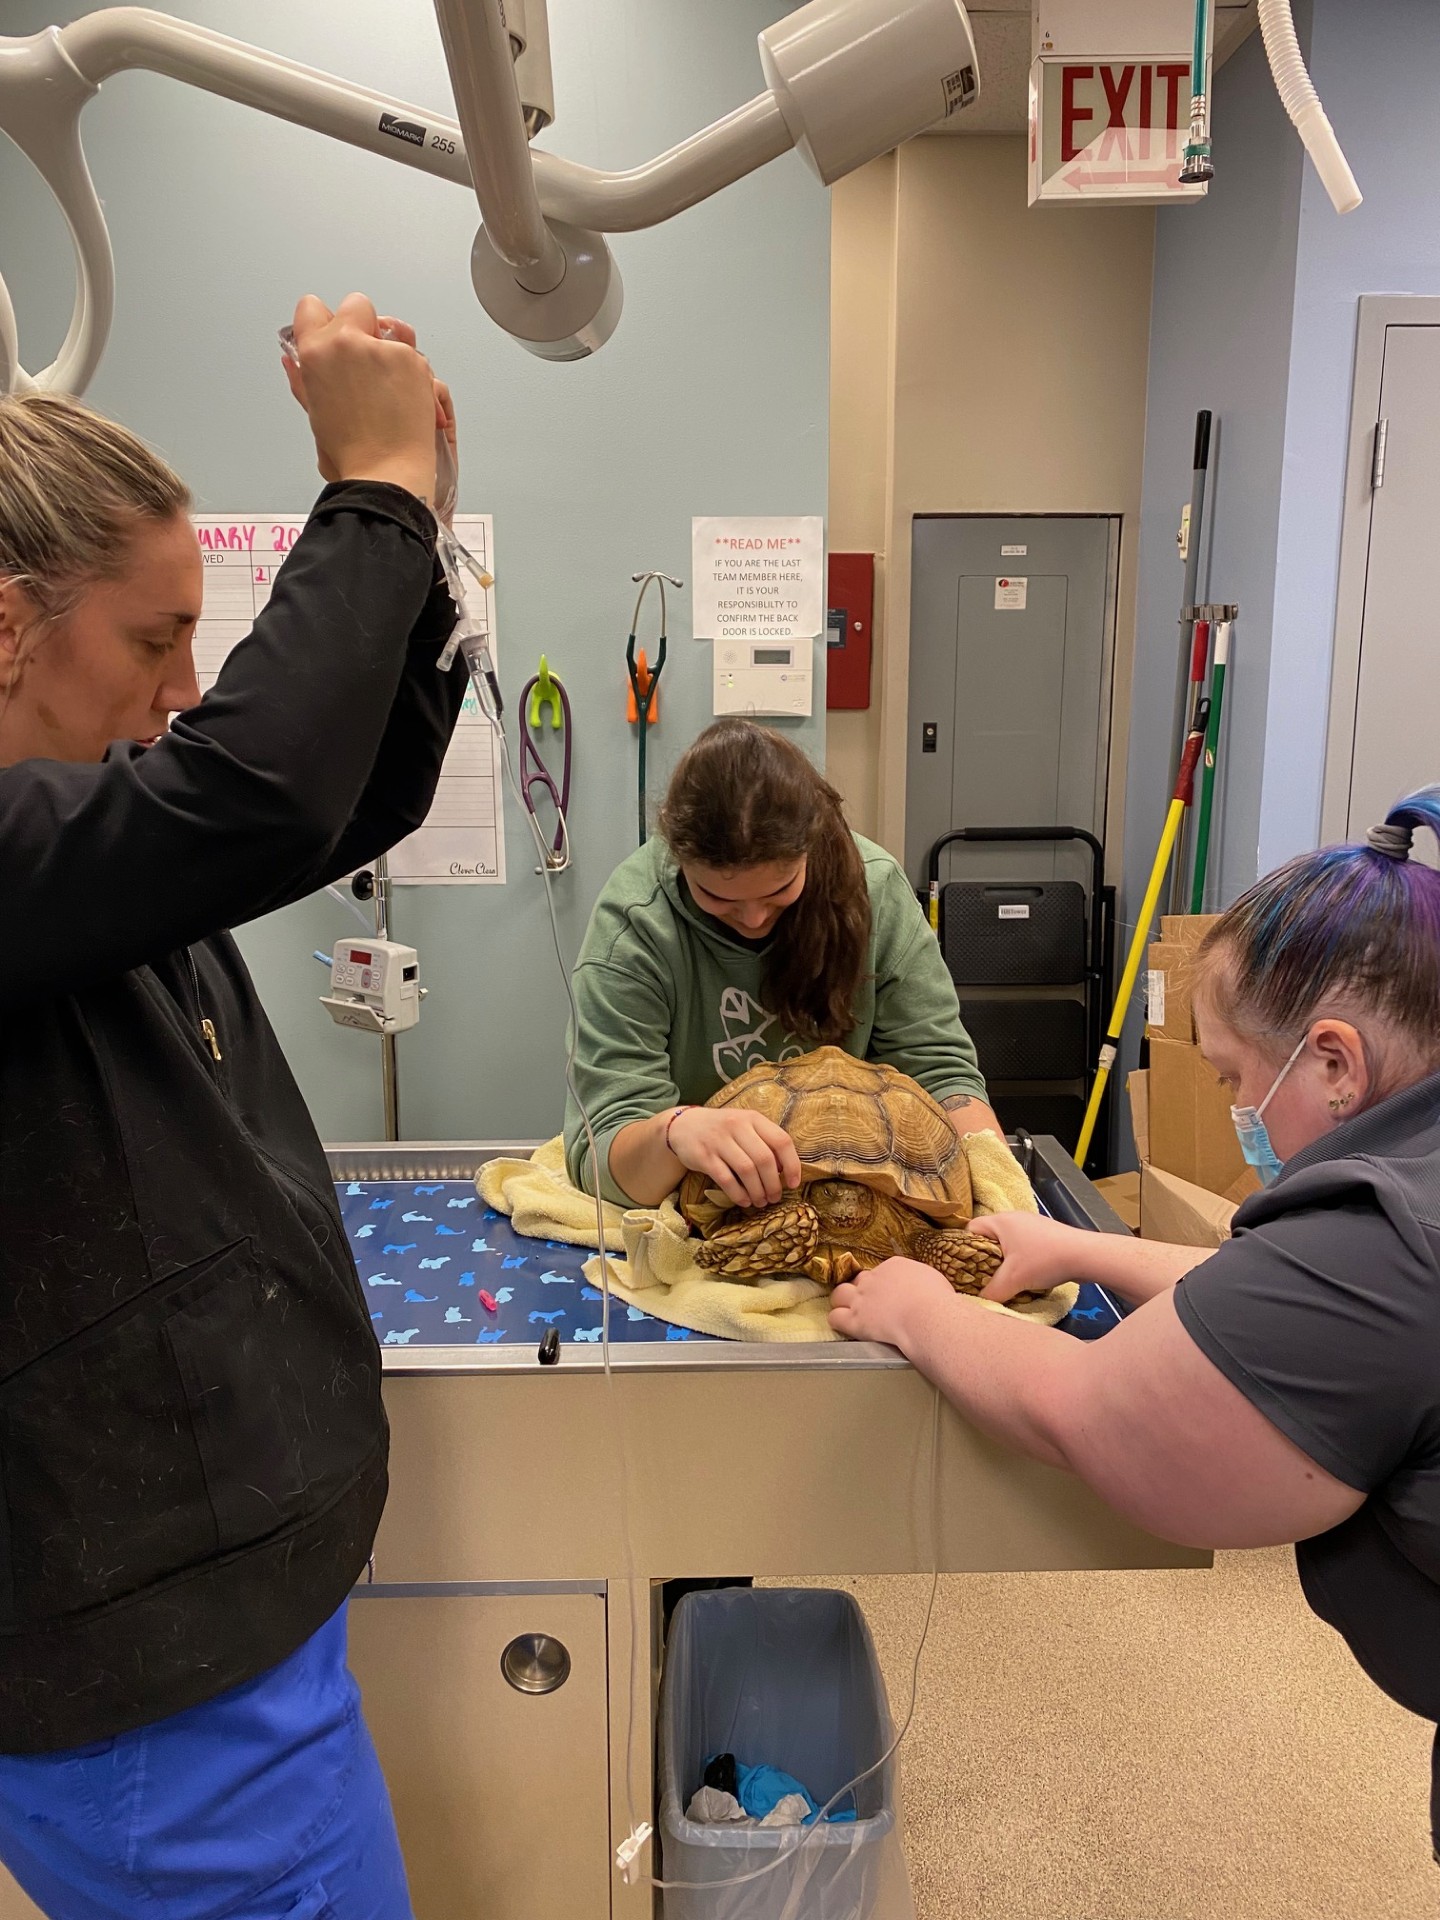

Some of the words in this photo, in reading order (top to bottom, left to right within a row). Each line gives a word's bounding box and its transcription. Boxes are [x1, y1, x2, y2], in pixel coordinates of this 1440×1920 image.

[1061, 64, 1190, 162] EXIT
[381, 122, 423, 143] MIDMARK
[431, 135, 456, 154] 255
[714, 559, 722, 567] IF
[725, 559, 742, 567] YOU
[745, 559, 760, 567] ARE
[764, 559, 779, 567] THE
[781, 559, 801, 567] LAST
[713, 573, 737, 581] TEAM
[739, 573, 777, 581] MEMBER
[780, 573, 803, 582] HERE,
[736, 587, 744, 595] IT
[746, 587, 754, 595] IS
[756, 587, 779, 595] YOUR
[787, 601, 798, 609] TO
[717, 614, 757, 622] CONFIRM
[759, 614, 774, 622] THE
[777, 614, 799, 622] BACK
[723, 628, 747, 636] DOOR
[749, 628, 757, 636] IS
[759, 628, 793, 636] LOCKED.
